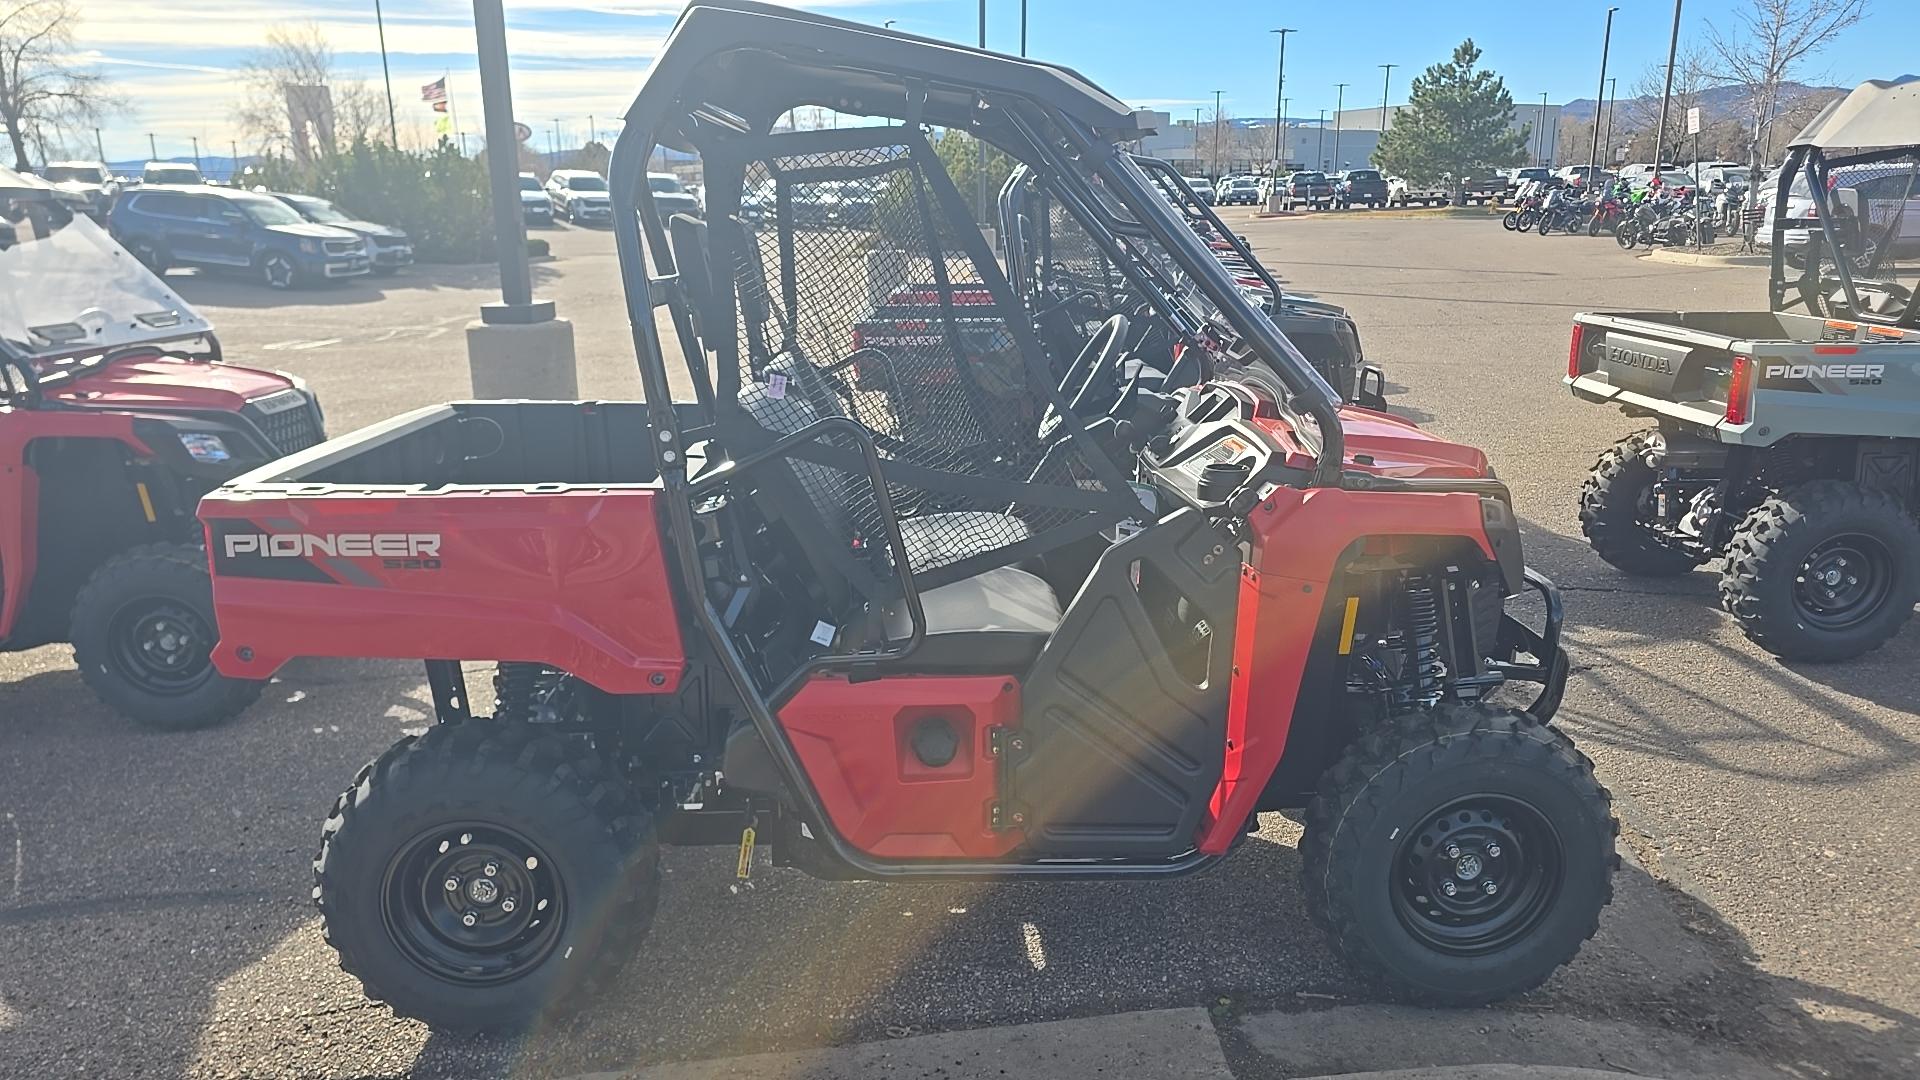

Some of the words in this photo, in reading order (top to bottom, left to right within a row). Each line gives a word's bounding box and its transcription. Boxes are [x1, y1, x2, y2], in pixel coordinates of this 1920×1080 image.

[1610, 345, 1673, 376] HONDA
[1765, 364, 1885, 379] PIONEER
[224, 534, 441, 558] PIONEER
[383, 559, 442, 569] 520
